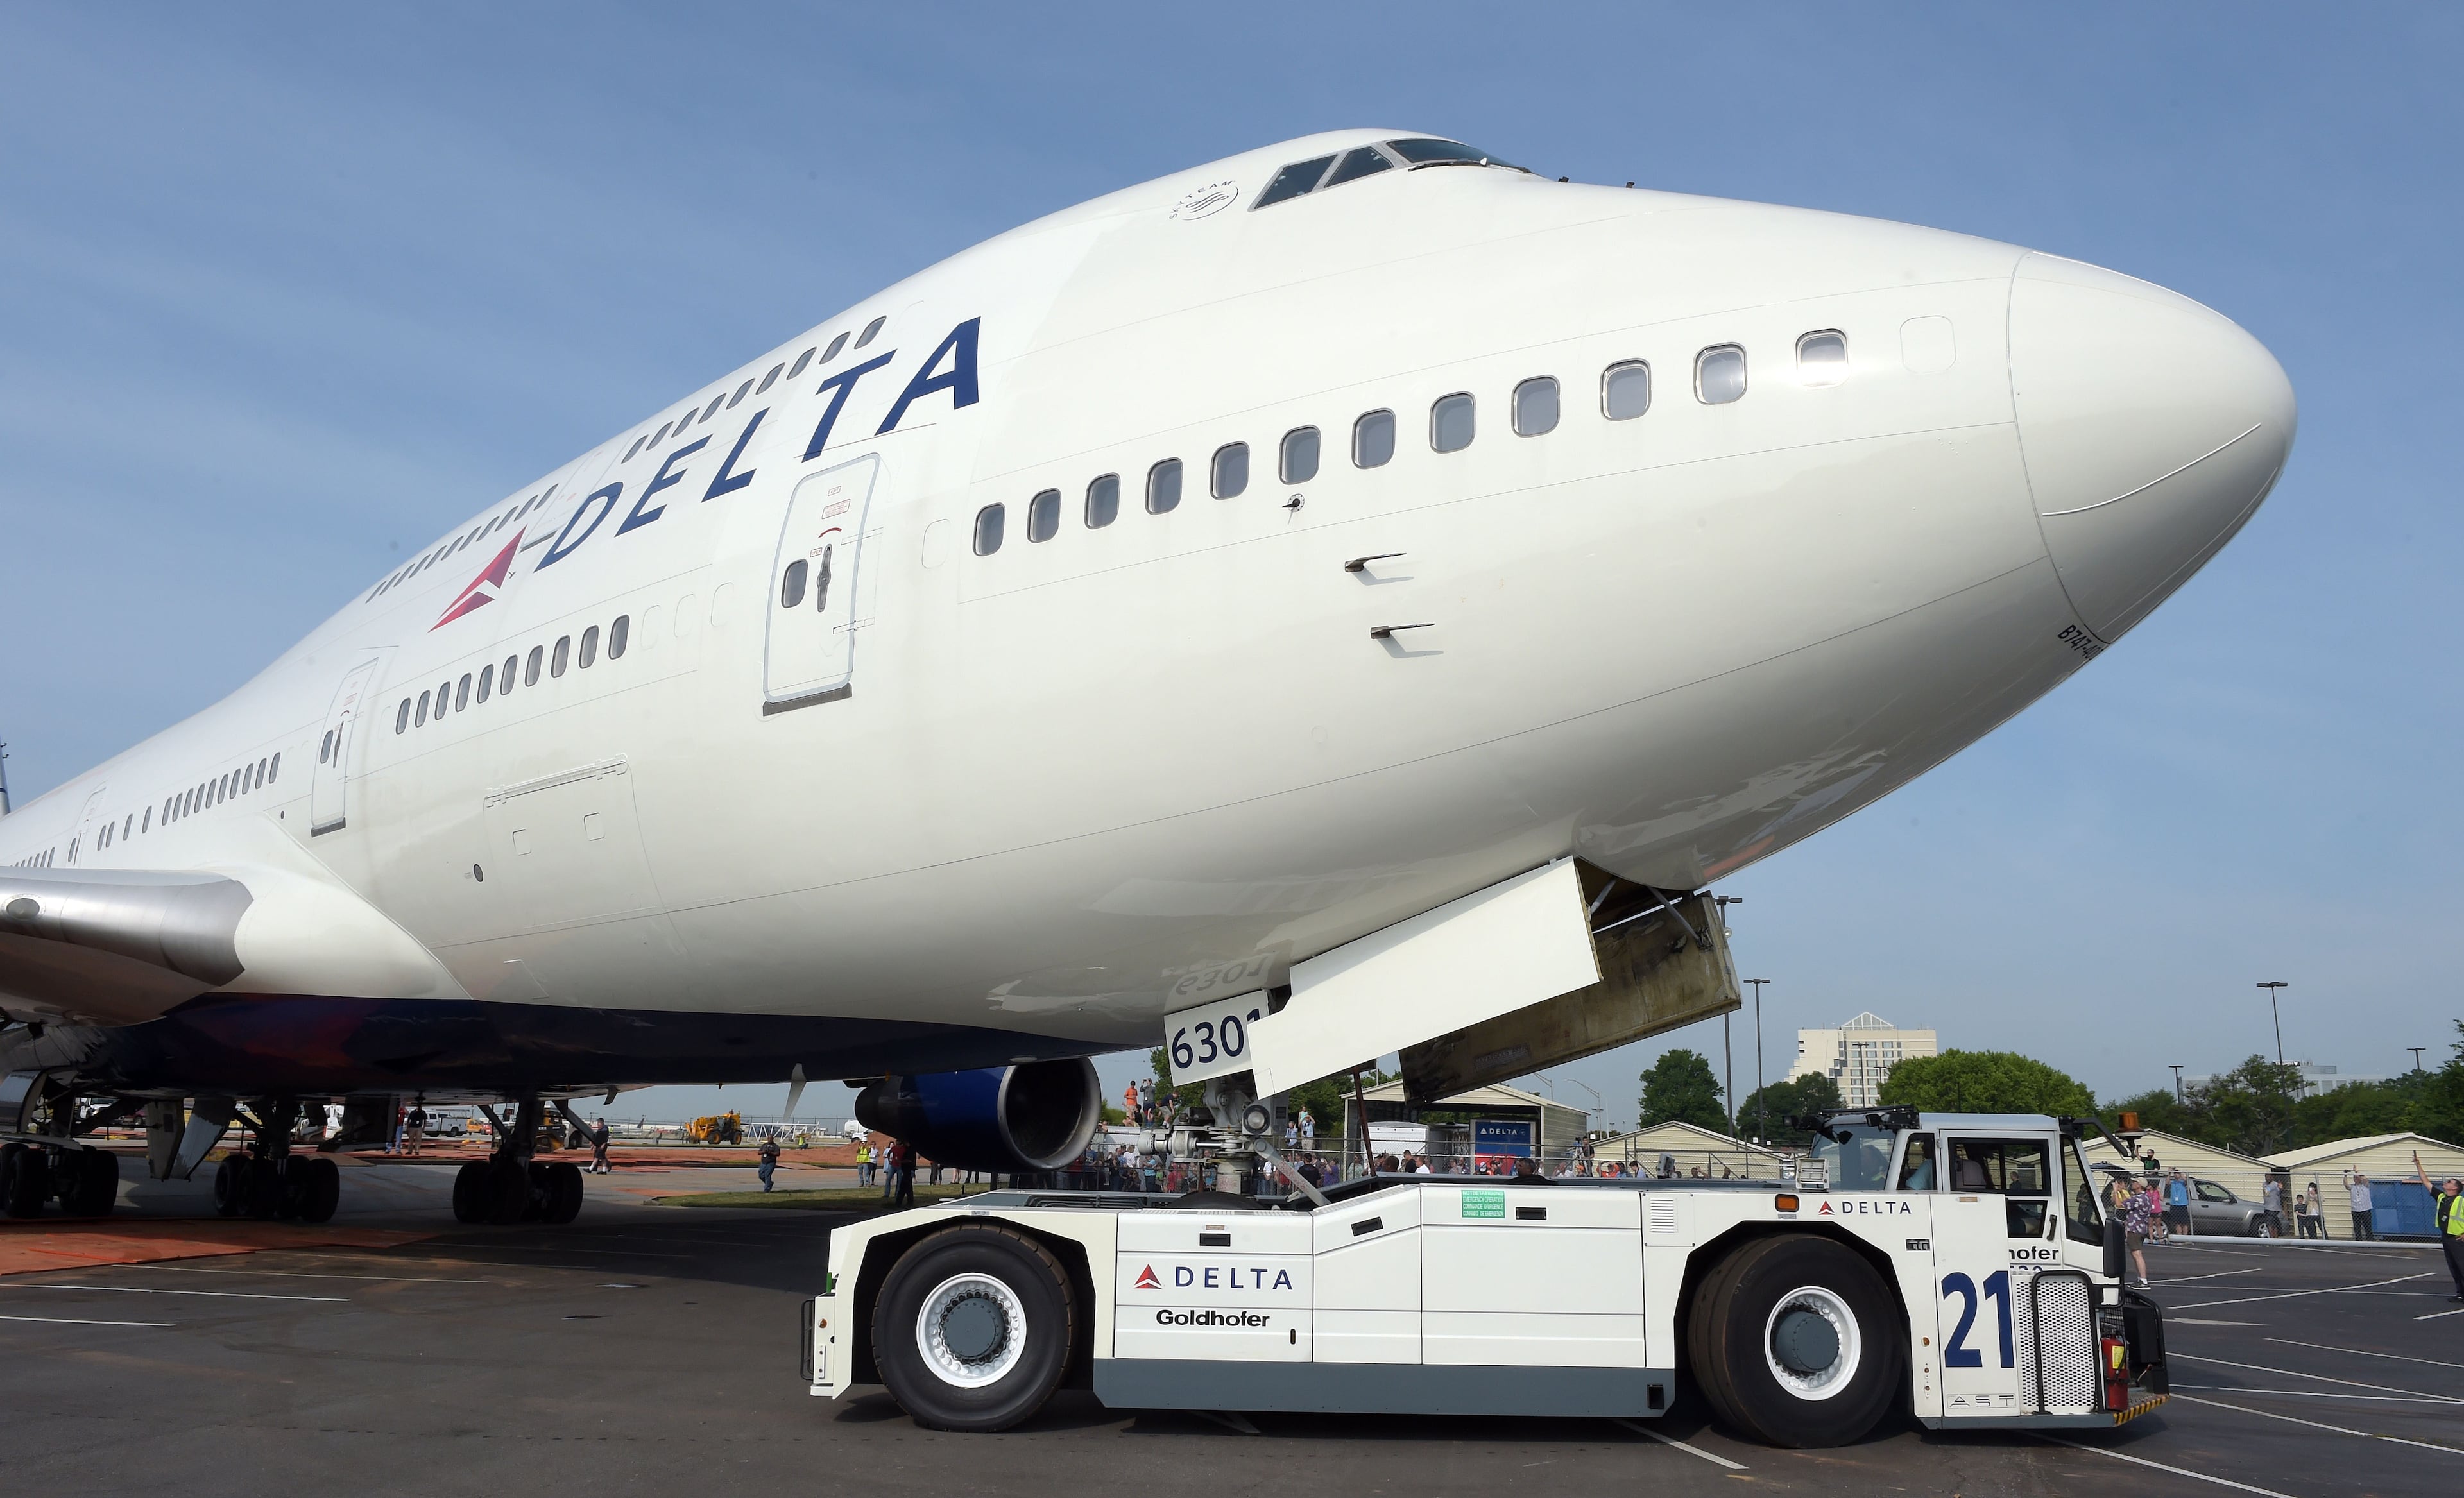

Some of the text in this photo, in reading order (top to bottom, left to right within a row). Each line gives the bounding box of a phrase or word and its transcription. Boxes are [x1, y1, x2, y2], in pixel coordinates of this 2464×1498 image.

[1169, 180, 1233, 219] SKYTEAM
[533, 316, 981, 572] DELTA
[1842, 1201, 1912, 1214] DELTA
[1175, 1266, 1293, 1290] DELTA
[1156, 1309, 1270, 1327] Goldhofer
[1940, 1270, 2015, 1368] 21
[1949, 1395, 2014, 1407] AST
